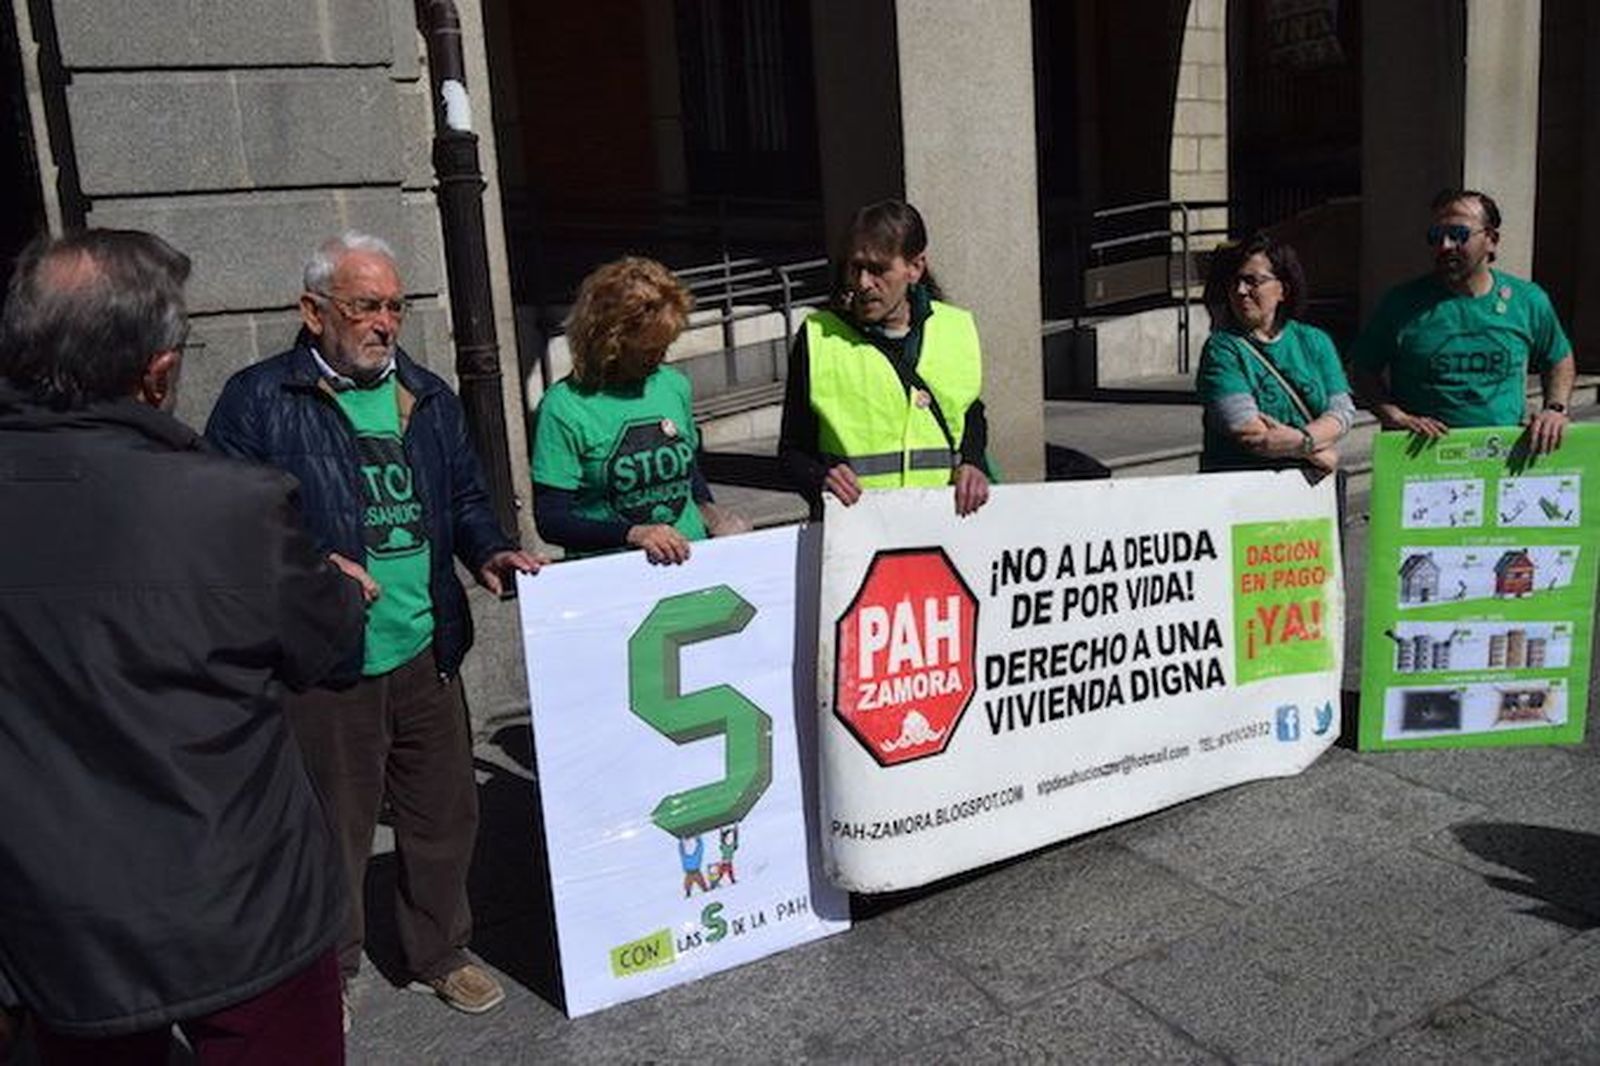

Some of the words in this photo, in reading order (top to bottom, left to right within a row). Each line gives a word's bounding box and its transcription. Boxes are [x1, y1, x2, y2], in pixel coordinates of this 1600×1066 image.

[1437, 352, 1504, 373] STOP
[614, 442, 693, 491] STOP
[990, 546, 1047, 597] ¡NO
[1056, 544, 1076, 580] A
[1084, 539, 1118, 575] LA
[1123, 529, 1218, 571] DEUDA
[1241, 572, 1267, 593] EN
[1273, 565, 1326, 589] PAGO
[1010, 590, 1054, 629] DE
[1062, 582, 1119, 622] POR
[1126, 570, 1195, 611] VIDA!
[1245, 598, 1323, 661] ¡YA!
[858, 594, 961, 680] PAH
[985, 632, 1128, 691] DERECHO
[1133, 628, 1152, 662] A
[1156, 618, 1223, 656] UNA
[857, 666, 963, 711] ZAMORA
[985, 674, 1125, 736] VIVIENDA
[1130, 657, 1227, 703] DIGNA
[619, 940, 660, 970] CON
[677, 931, 702, 954] LAS
[701, 902, 728, 943] S
[731, 918, 747, 936] DE
[751, 911, 767, 929] LA
[777, 896, 808, 921] PAH
